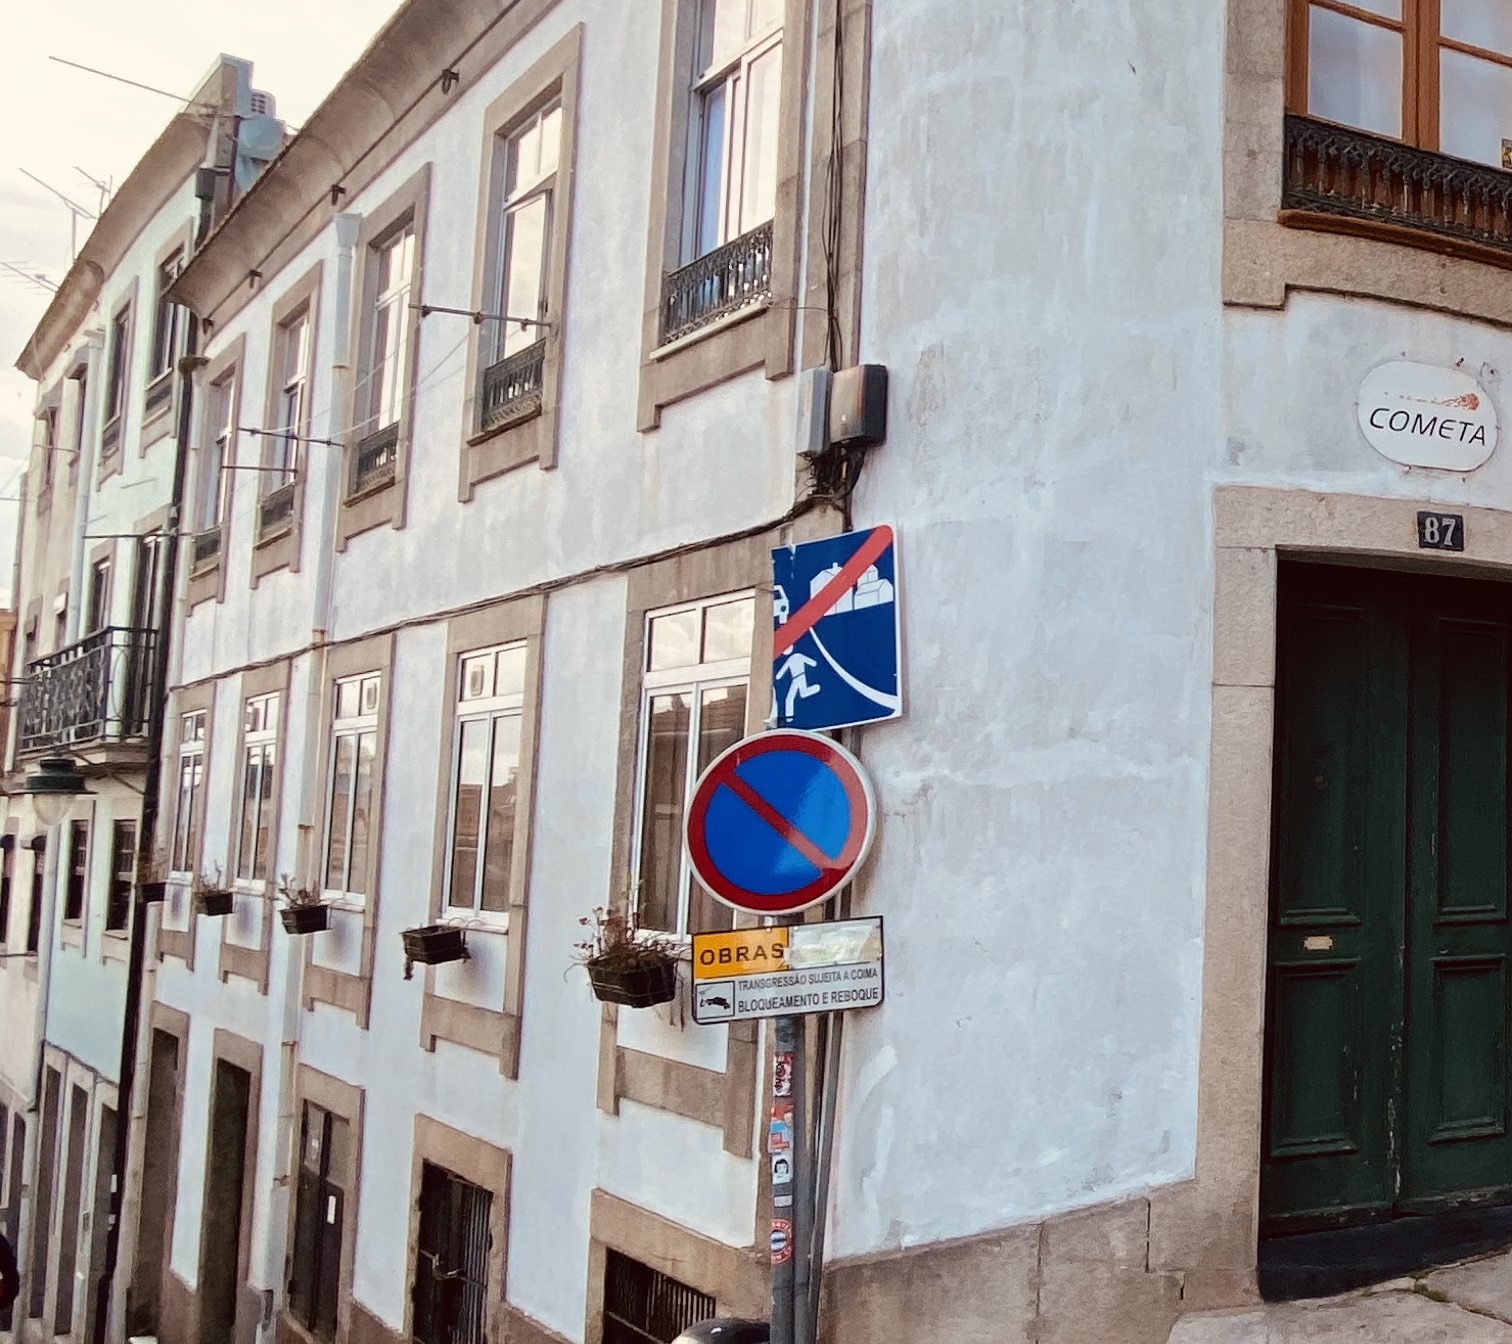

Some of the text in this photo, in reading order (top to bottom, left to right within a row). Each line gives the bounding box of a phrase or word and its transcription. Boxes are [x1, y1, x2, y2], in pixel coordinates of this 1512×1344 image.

[1369, 407, 1486, 446] COMETA
[1423, 516, 1457, 546] 87
[699, 942, 784, 966] OBRAS
[738, 968, 877, 991] TRANSGRESSÃO SUJEITA A COIMA
[738, 987, 879, 1013] BLOQUEAMENTO E REBOQUE
